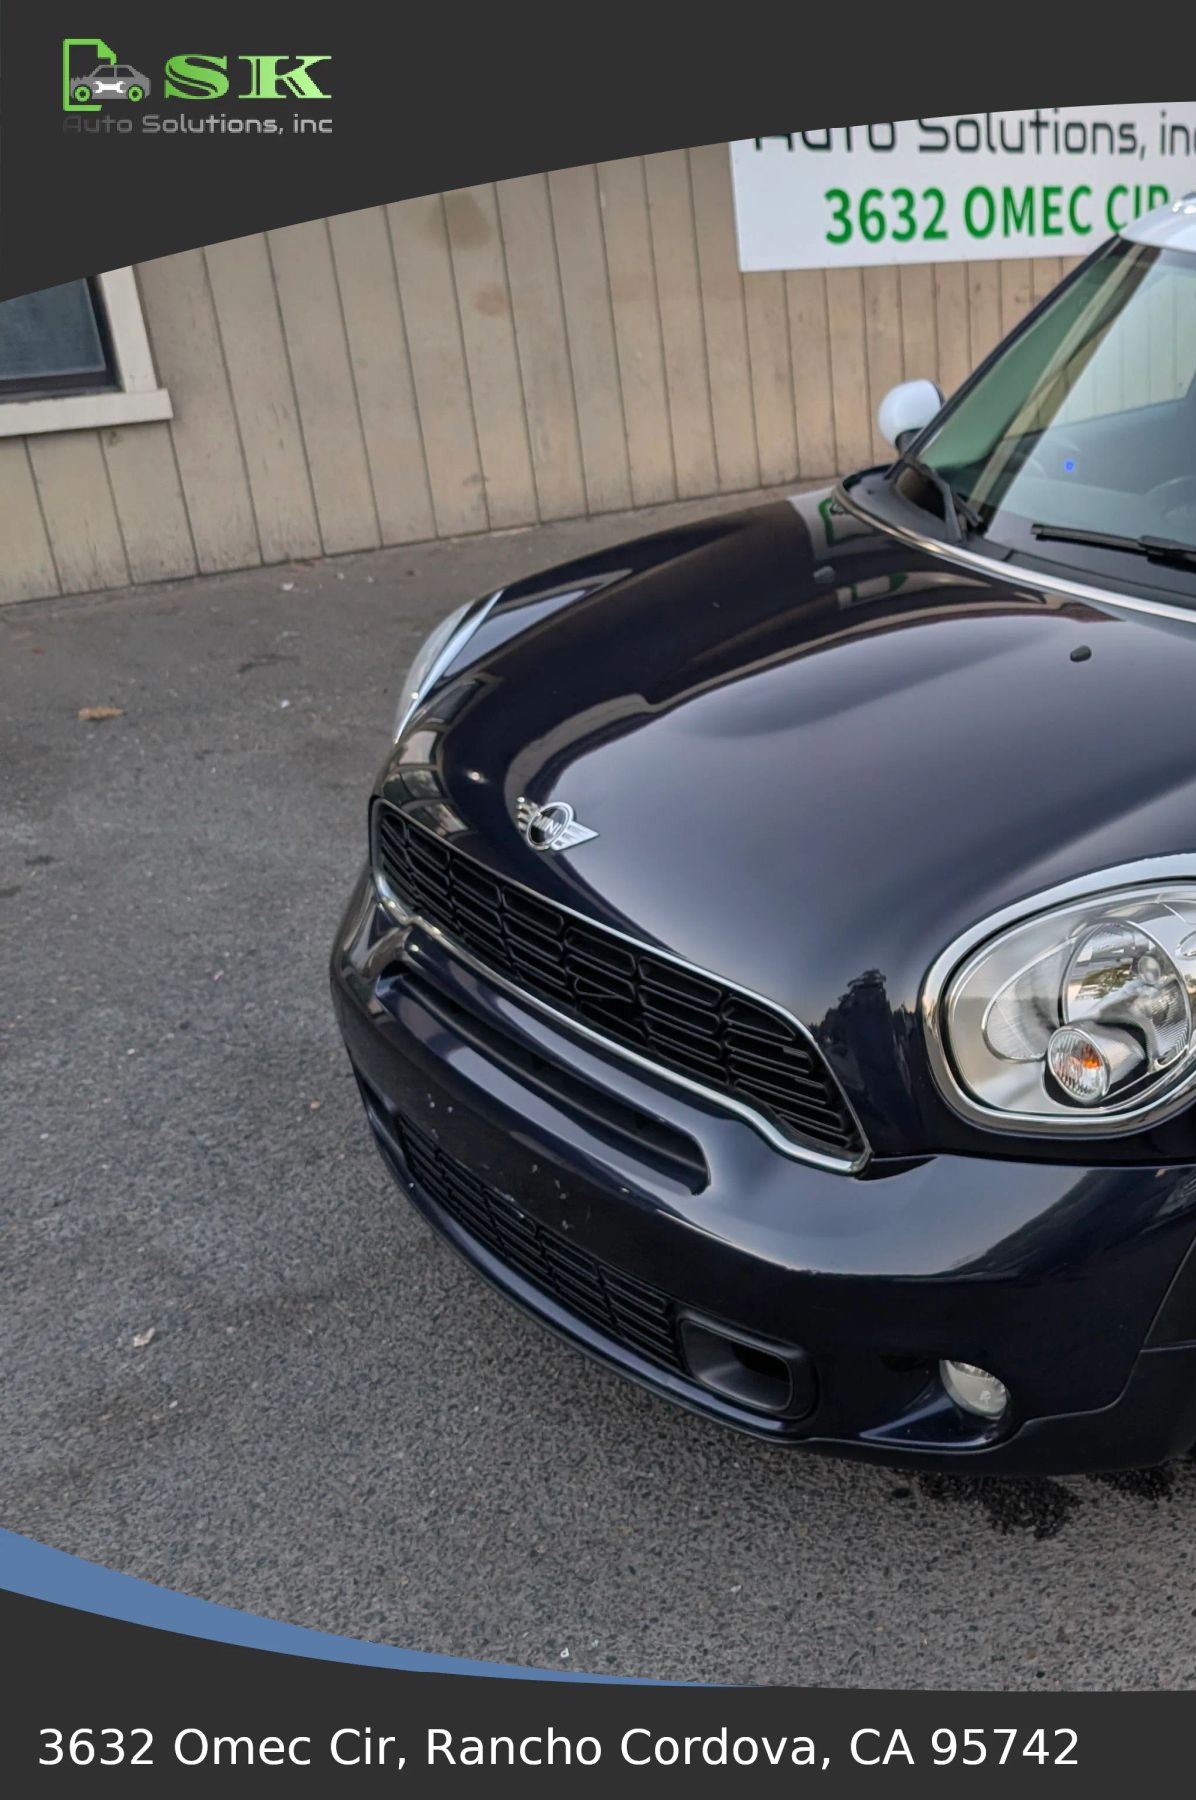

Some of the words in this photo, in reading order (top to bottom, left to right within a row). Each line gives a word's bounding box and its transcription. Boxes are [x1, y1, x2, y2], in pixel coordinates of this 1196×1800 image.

[918, 109, 1146, 161] Solutions,
[825, 187, 948, 245] 3632
[963, 183, 1093, 239] OMEC
[534, 815, 563, 836] MINI
